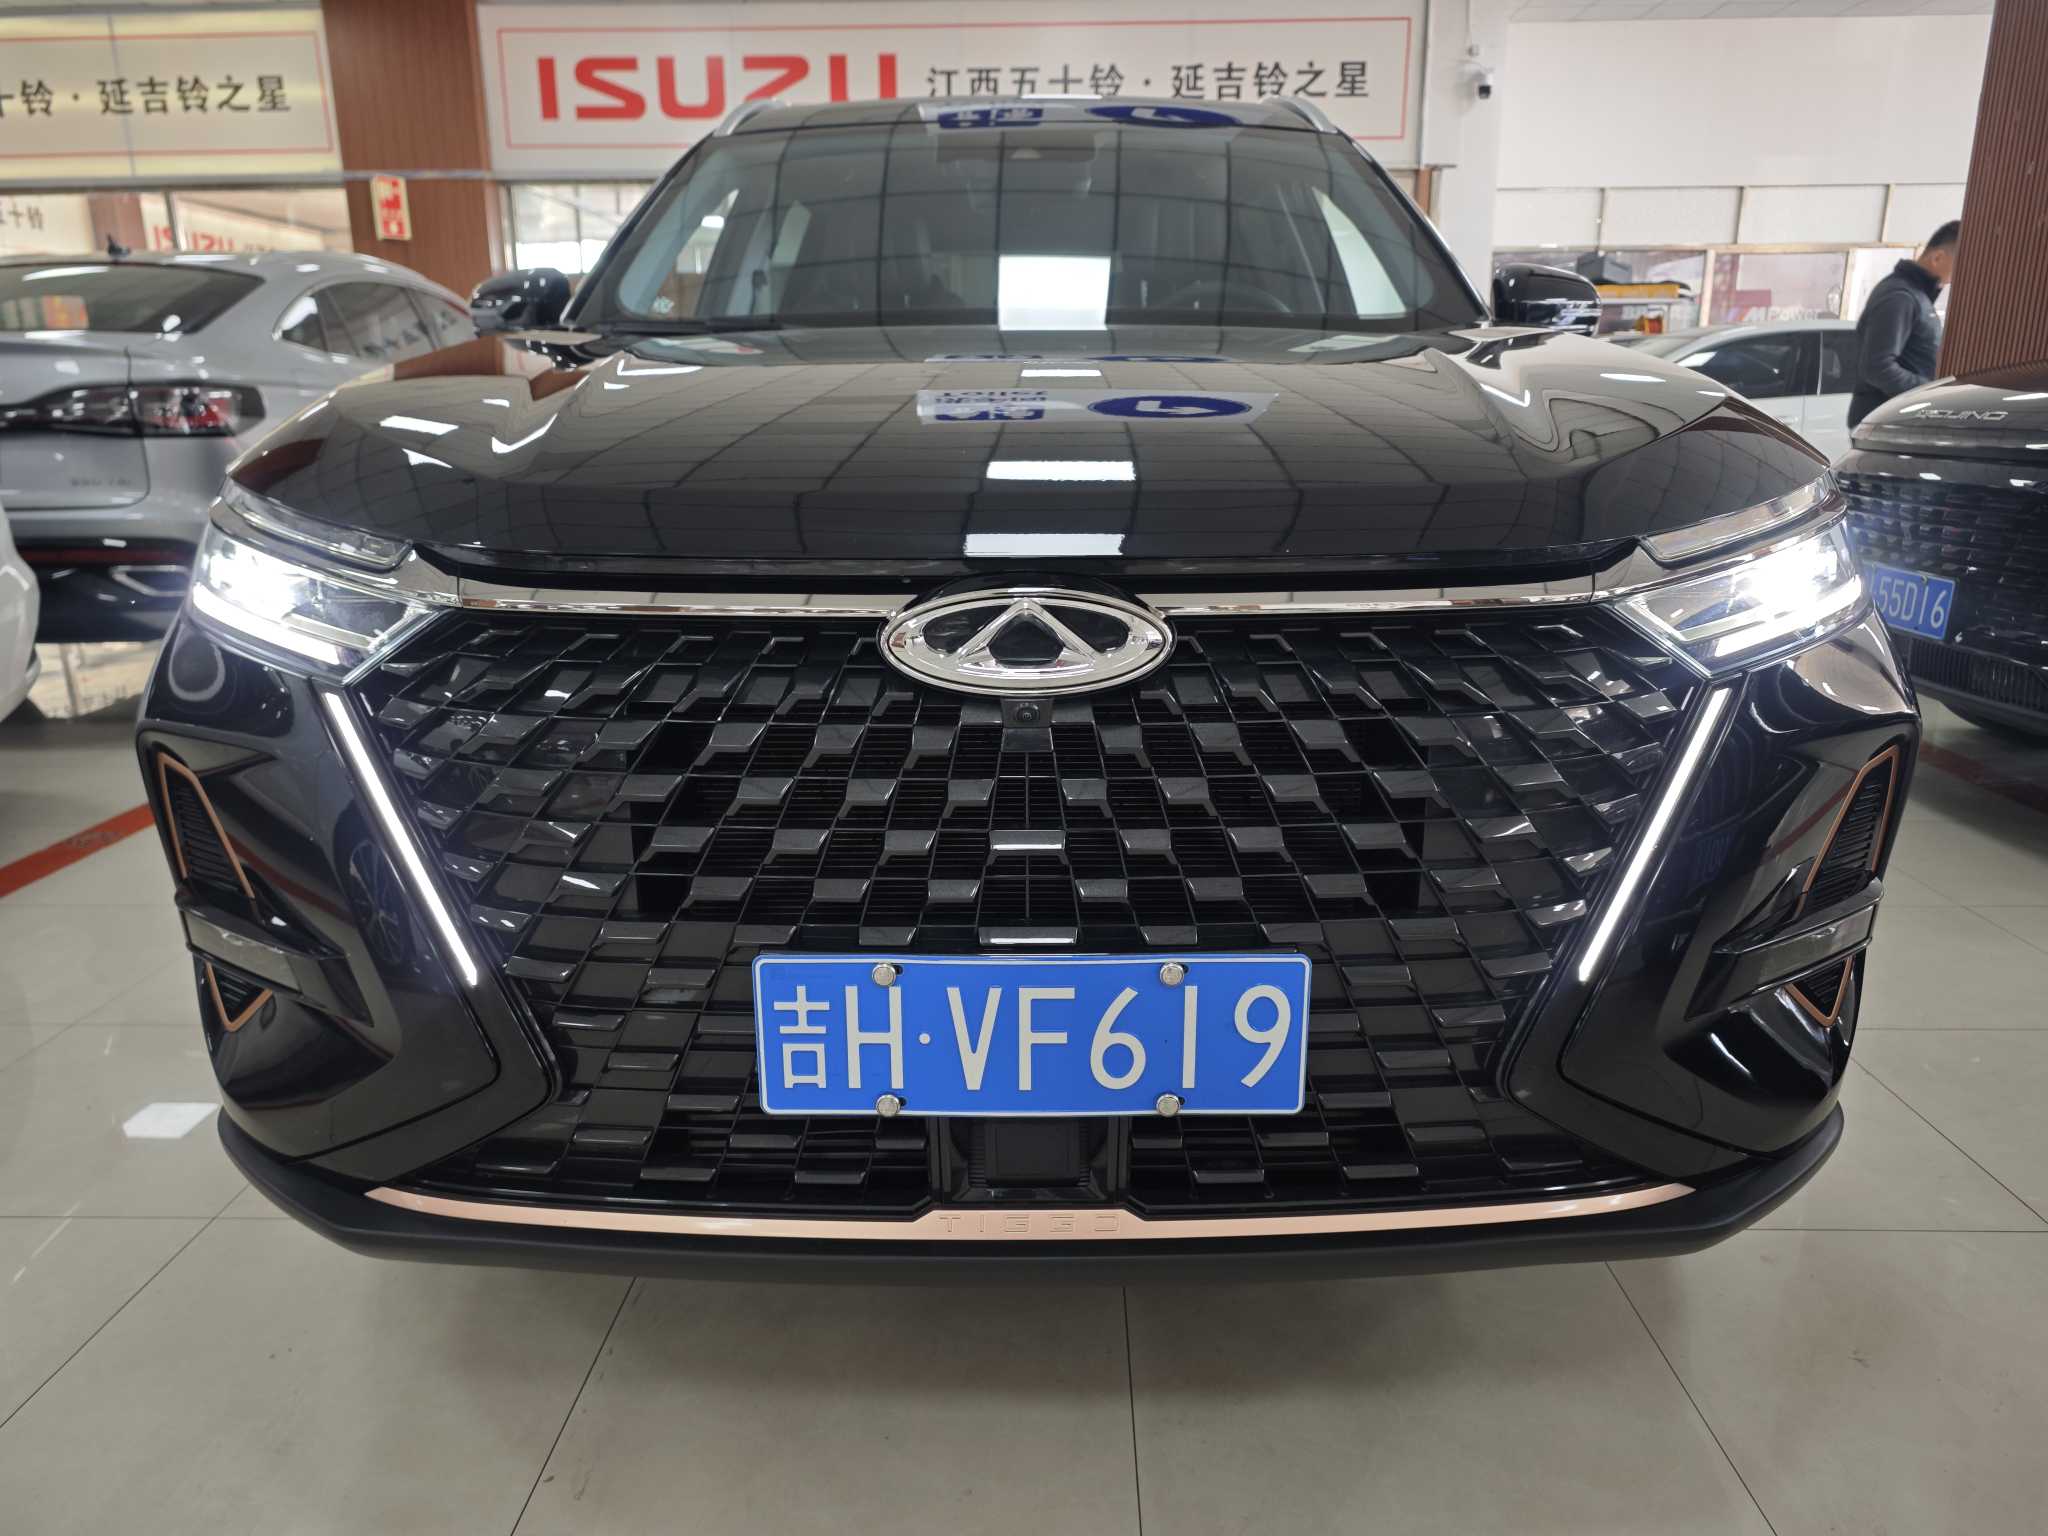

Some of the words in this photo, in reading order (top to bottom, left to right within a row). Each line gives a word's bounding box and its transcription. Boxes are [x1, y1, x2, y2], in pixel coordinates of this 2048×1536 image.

[537, 53, 897, 121] ISUZU
[773, 984, 1292, 1091] 吉H·VF619
[939, 1214, 1119, 1233] TIGGO
